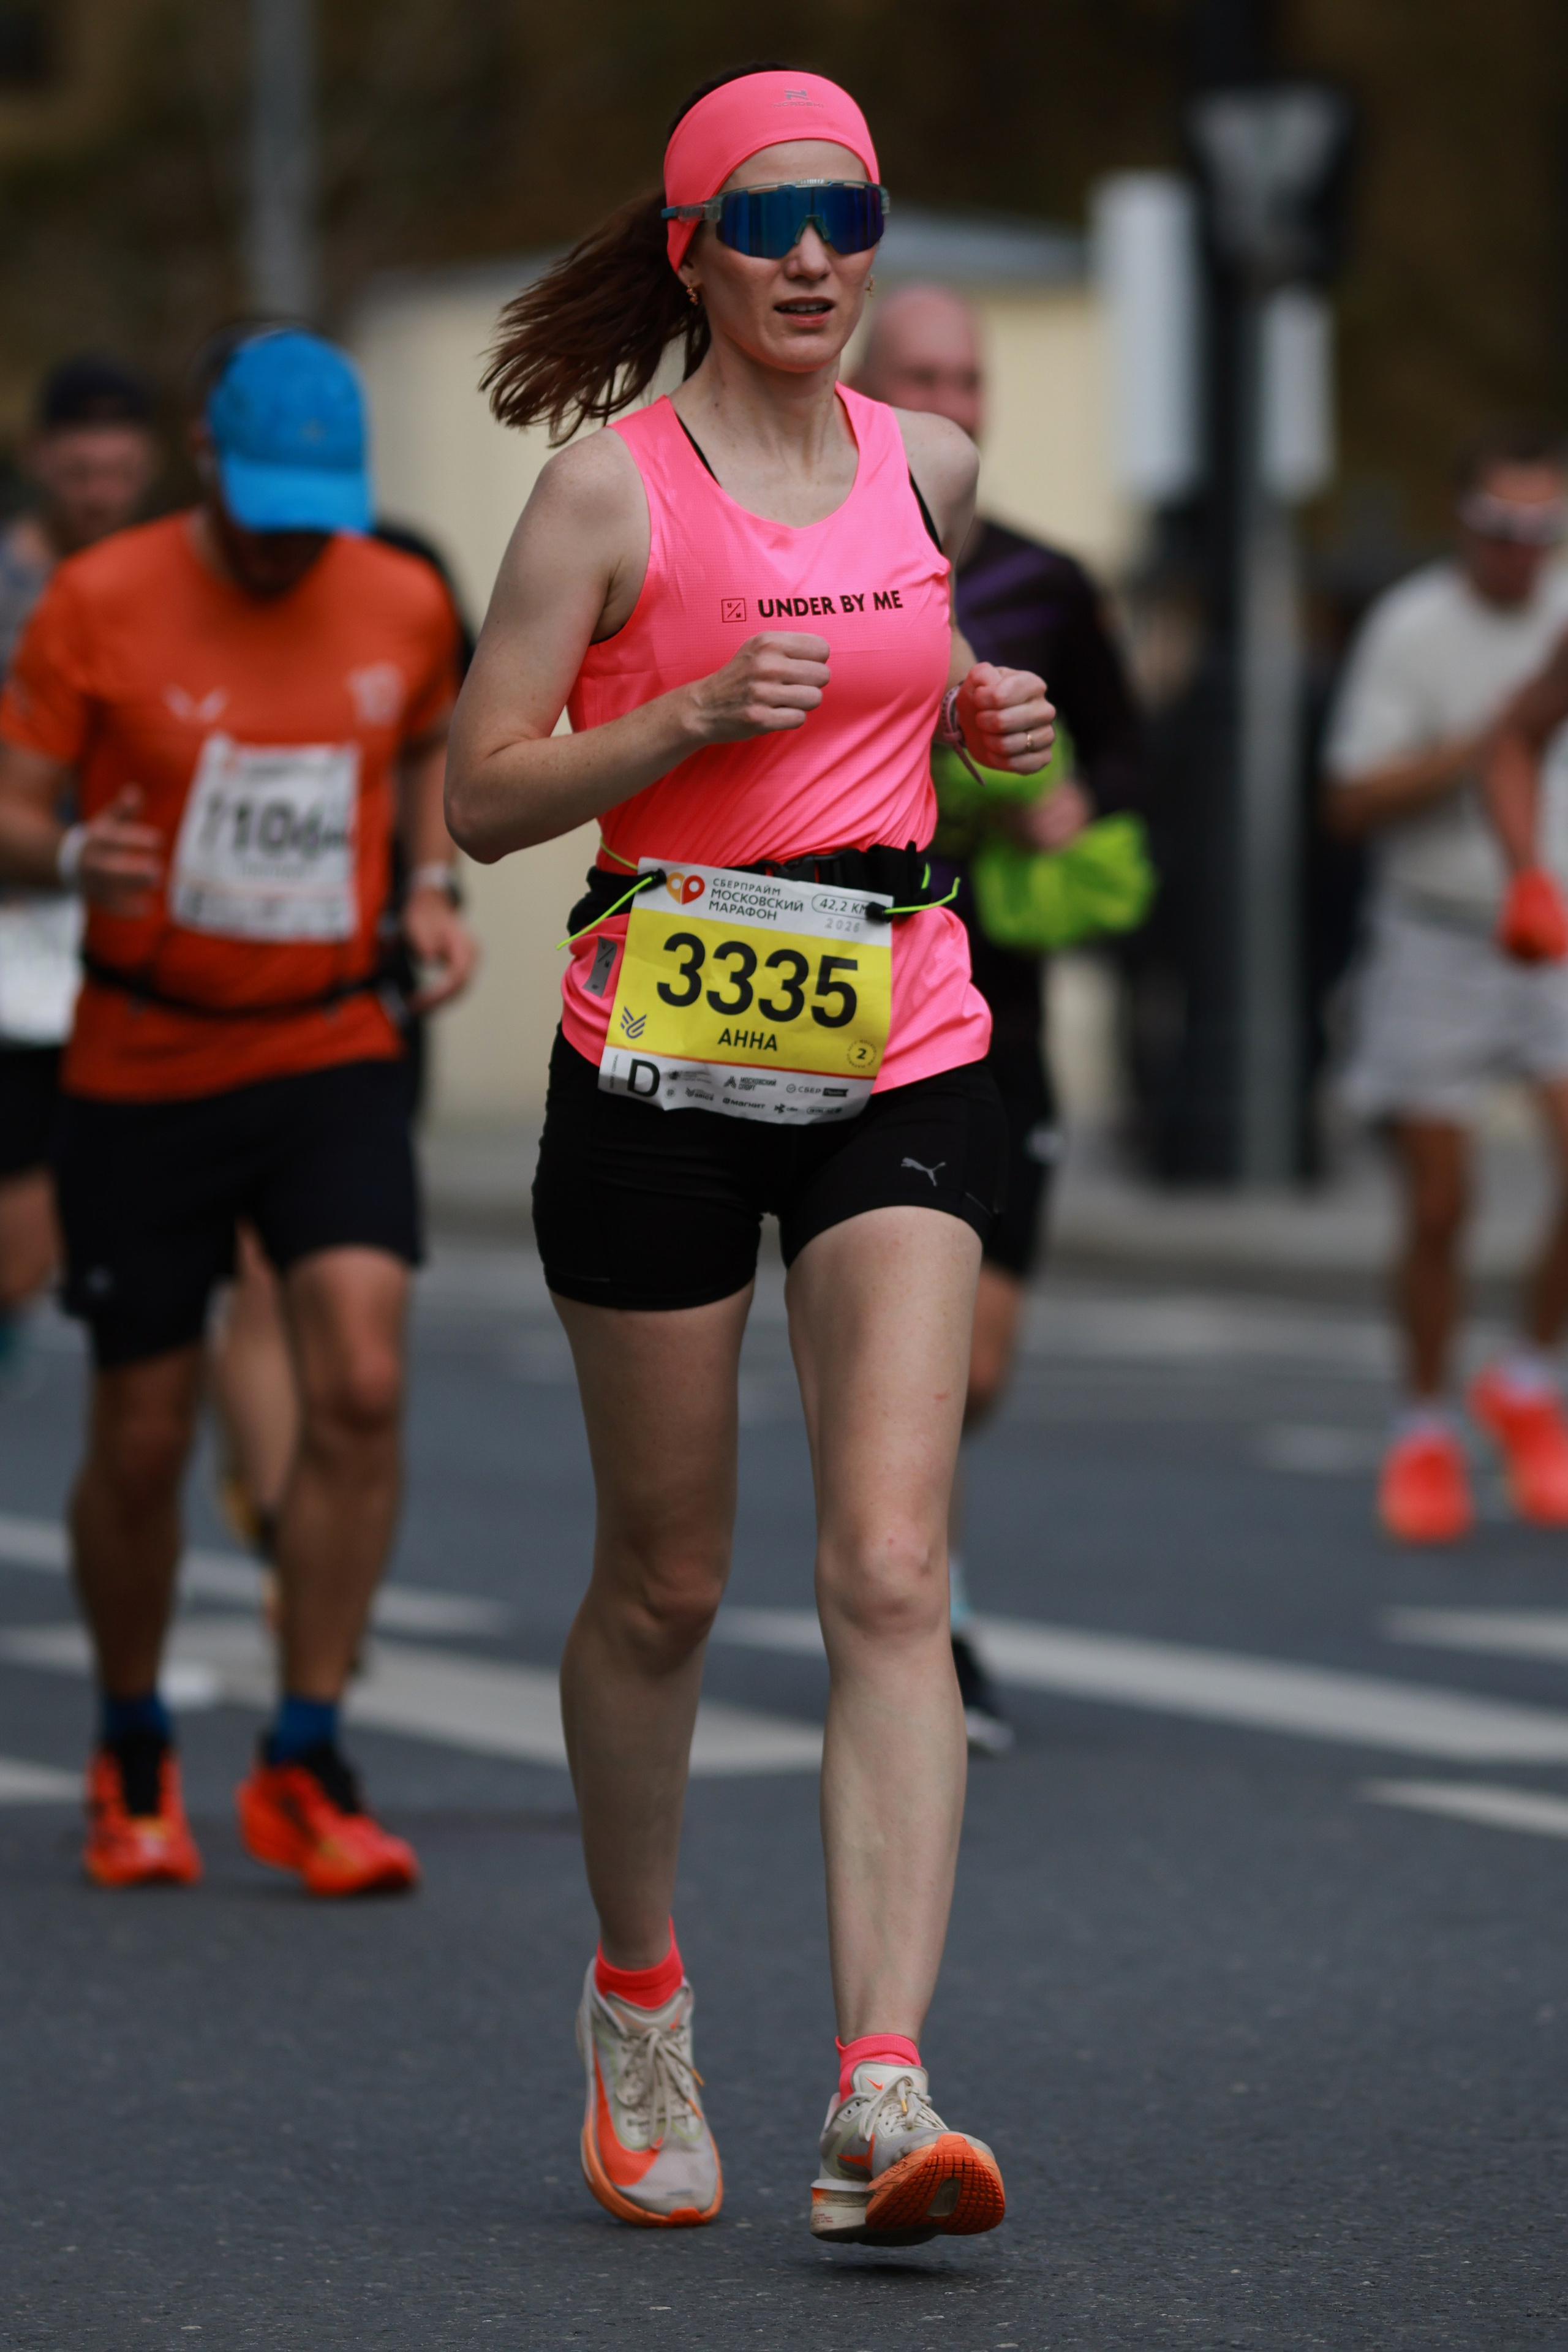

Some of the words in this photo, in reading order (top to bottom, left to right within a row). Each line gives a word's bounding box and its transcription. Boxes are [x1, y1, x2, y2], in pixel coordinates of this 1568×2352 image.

[758, 597, 837, 618] UNDER
[839, 594, 865, 613] BY
[873, 590, 903, 611] ME
[712, 878, 781, 896] СБЕРПРАЙМ
[709, 900, 777, 921] МАРАФОН
[710, 888, 804, 912] МОСКОВСКИЙ
[820, 898, 848, 912] 42,2
[824, 918, 860, 933] 2026
[657, 932, 858, 1028] 3335
[717, 1028, 778, 1052] АННА
[856, 1047, 867, 1060] 2
[627, 1058, 660, 1097] D
[739, 1077, 777, 1087] МОСКОВСКИЙ
